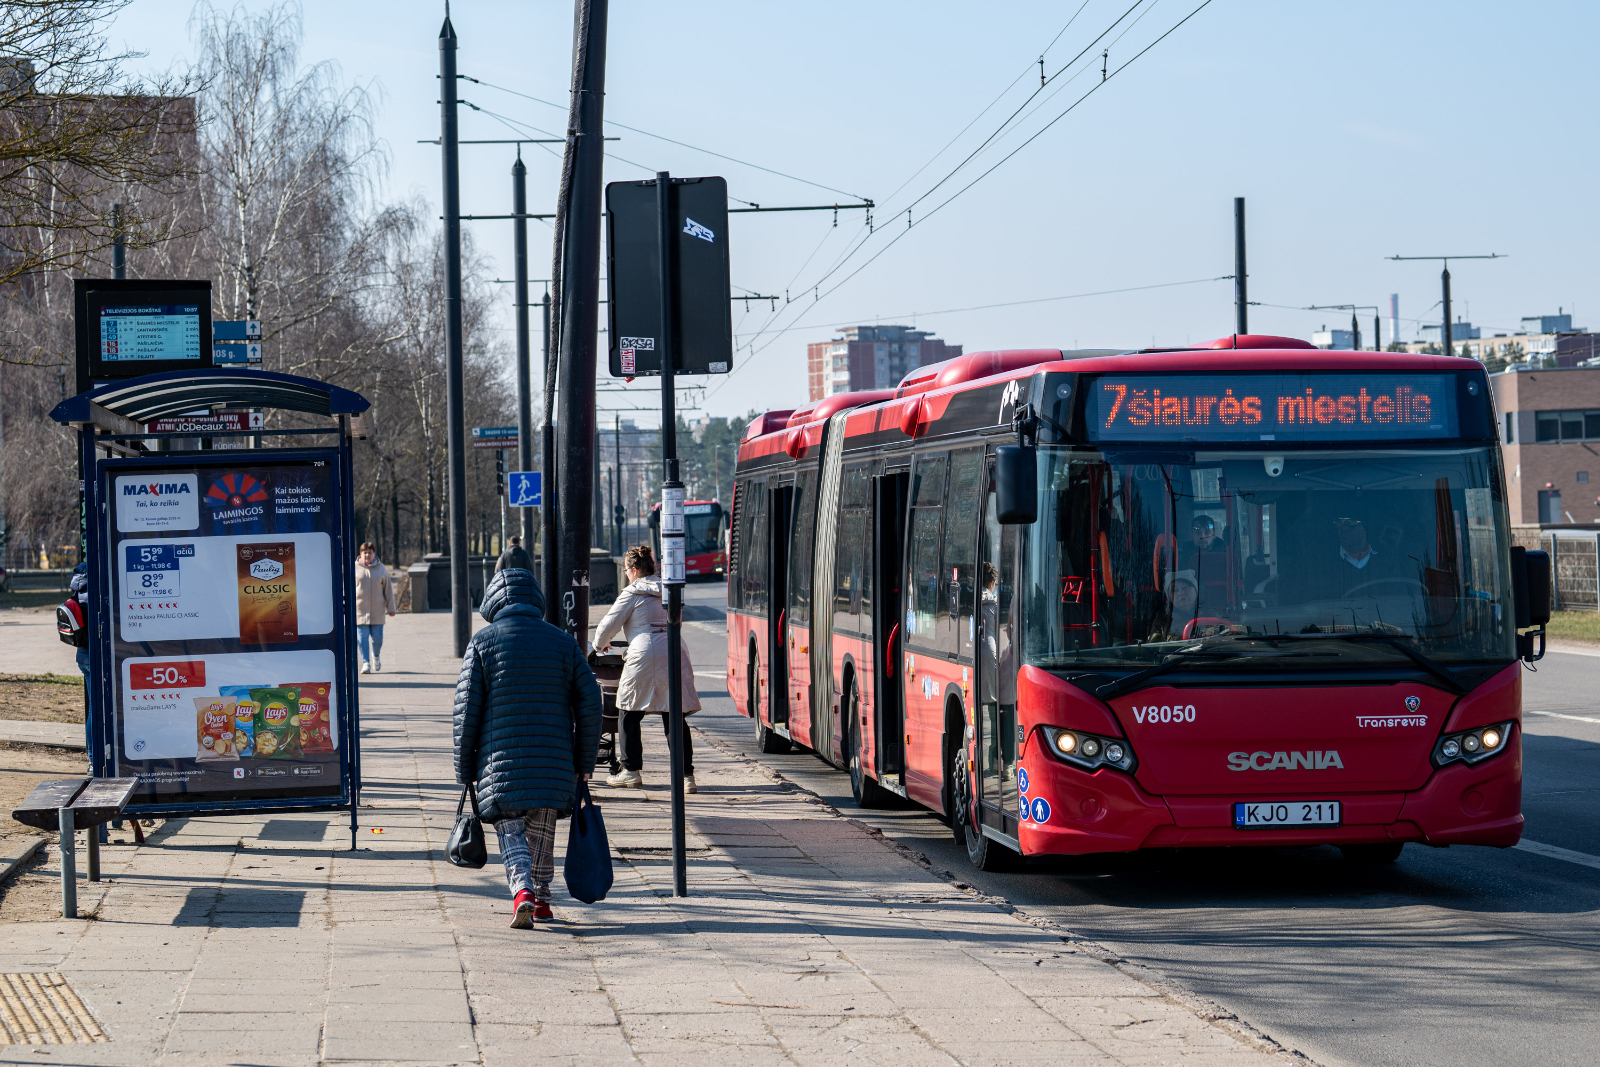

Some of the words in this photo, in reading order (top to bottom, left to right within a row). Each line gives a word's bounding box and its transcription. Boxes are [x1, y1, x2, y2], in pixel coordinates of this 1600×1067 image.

[1104, 384, 1126, 428] 7
[1128, 389, 1262, 425] šiaurės
[1278, 386, 1432, 424] miestelis
[176, 423, 224, 432] JCDecaux
[123, 482, 190, 496] MAXIMA
[213, 506, 264, 520] LAIMINGOS
[141, 548, 151, 562] 5
[253, 565, 280, 574] Paulig
[142, 574, 152, 588] 8
[244, 584, 290, 594] CLASSIC
[146, 667, 187, 684] -50%
[236, 704, 253, 717] Lay
[266, 708, 287, 720] Lay's
[1132, 705, 1196, 724] V8050
[204, 712, 228, 725] Oven
[1356, 714, 1428, 728] Transrevis
[1226, 750, 1344, 771] SCANIA
[1248, 804, 1288, 822] KJO
[1302, 804, 1335, 822] 211
